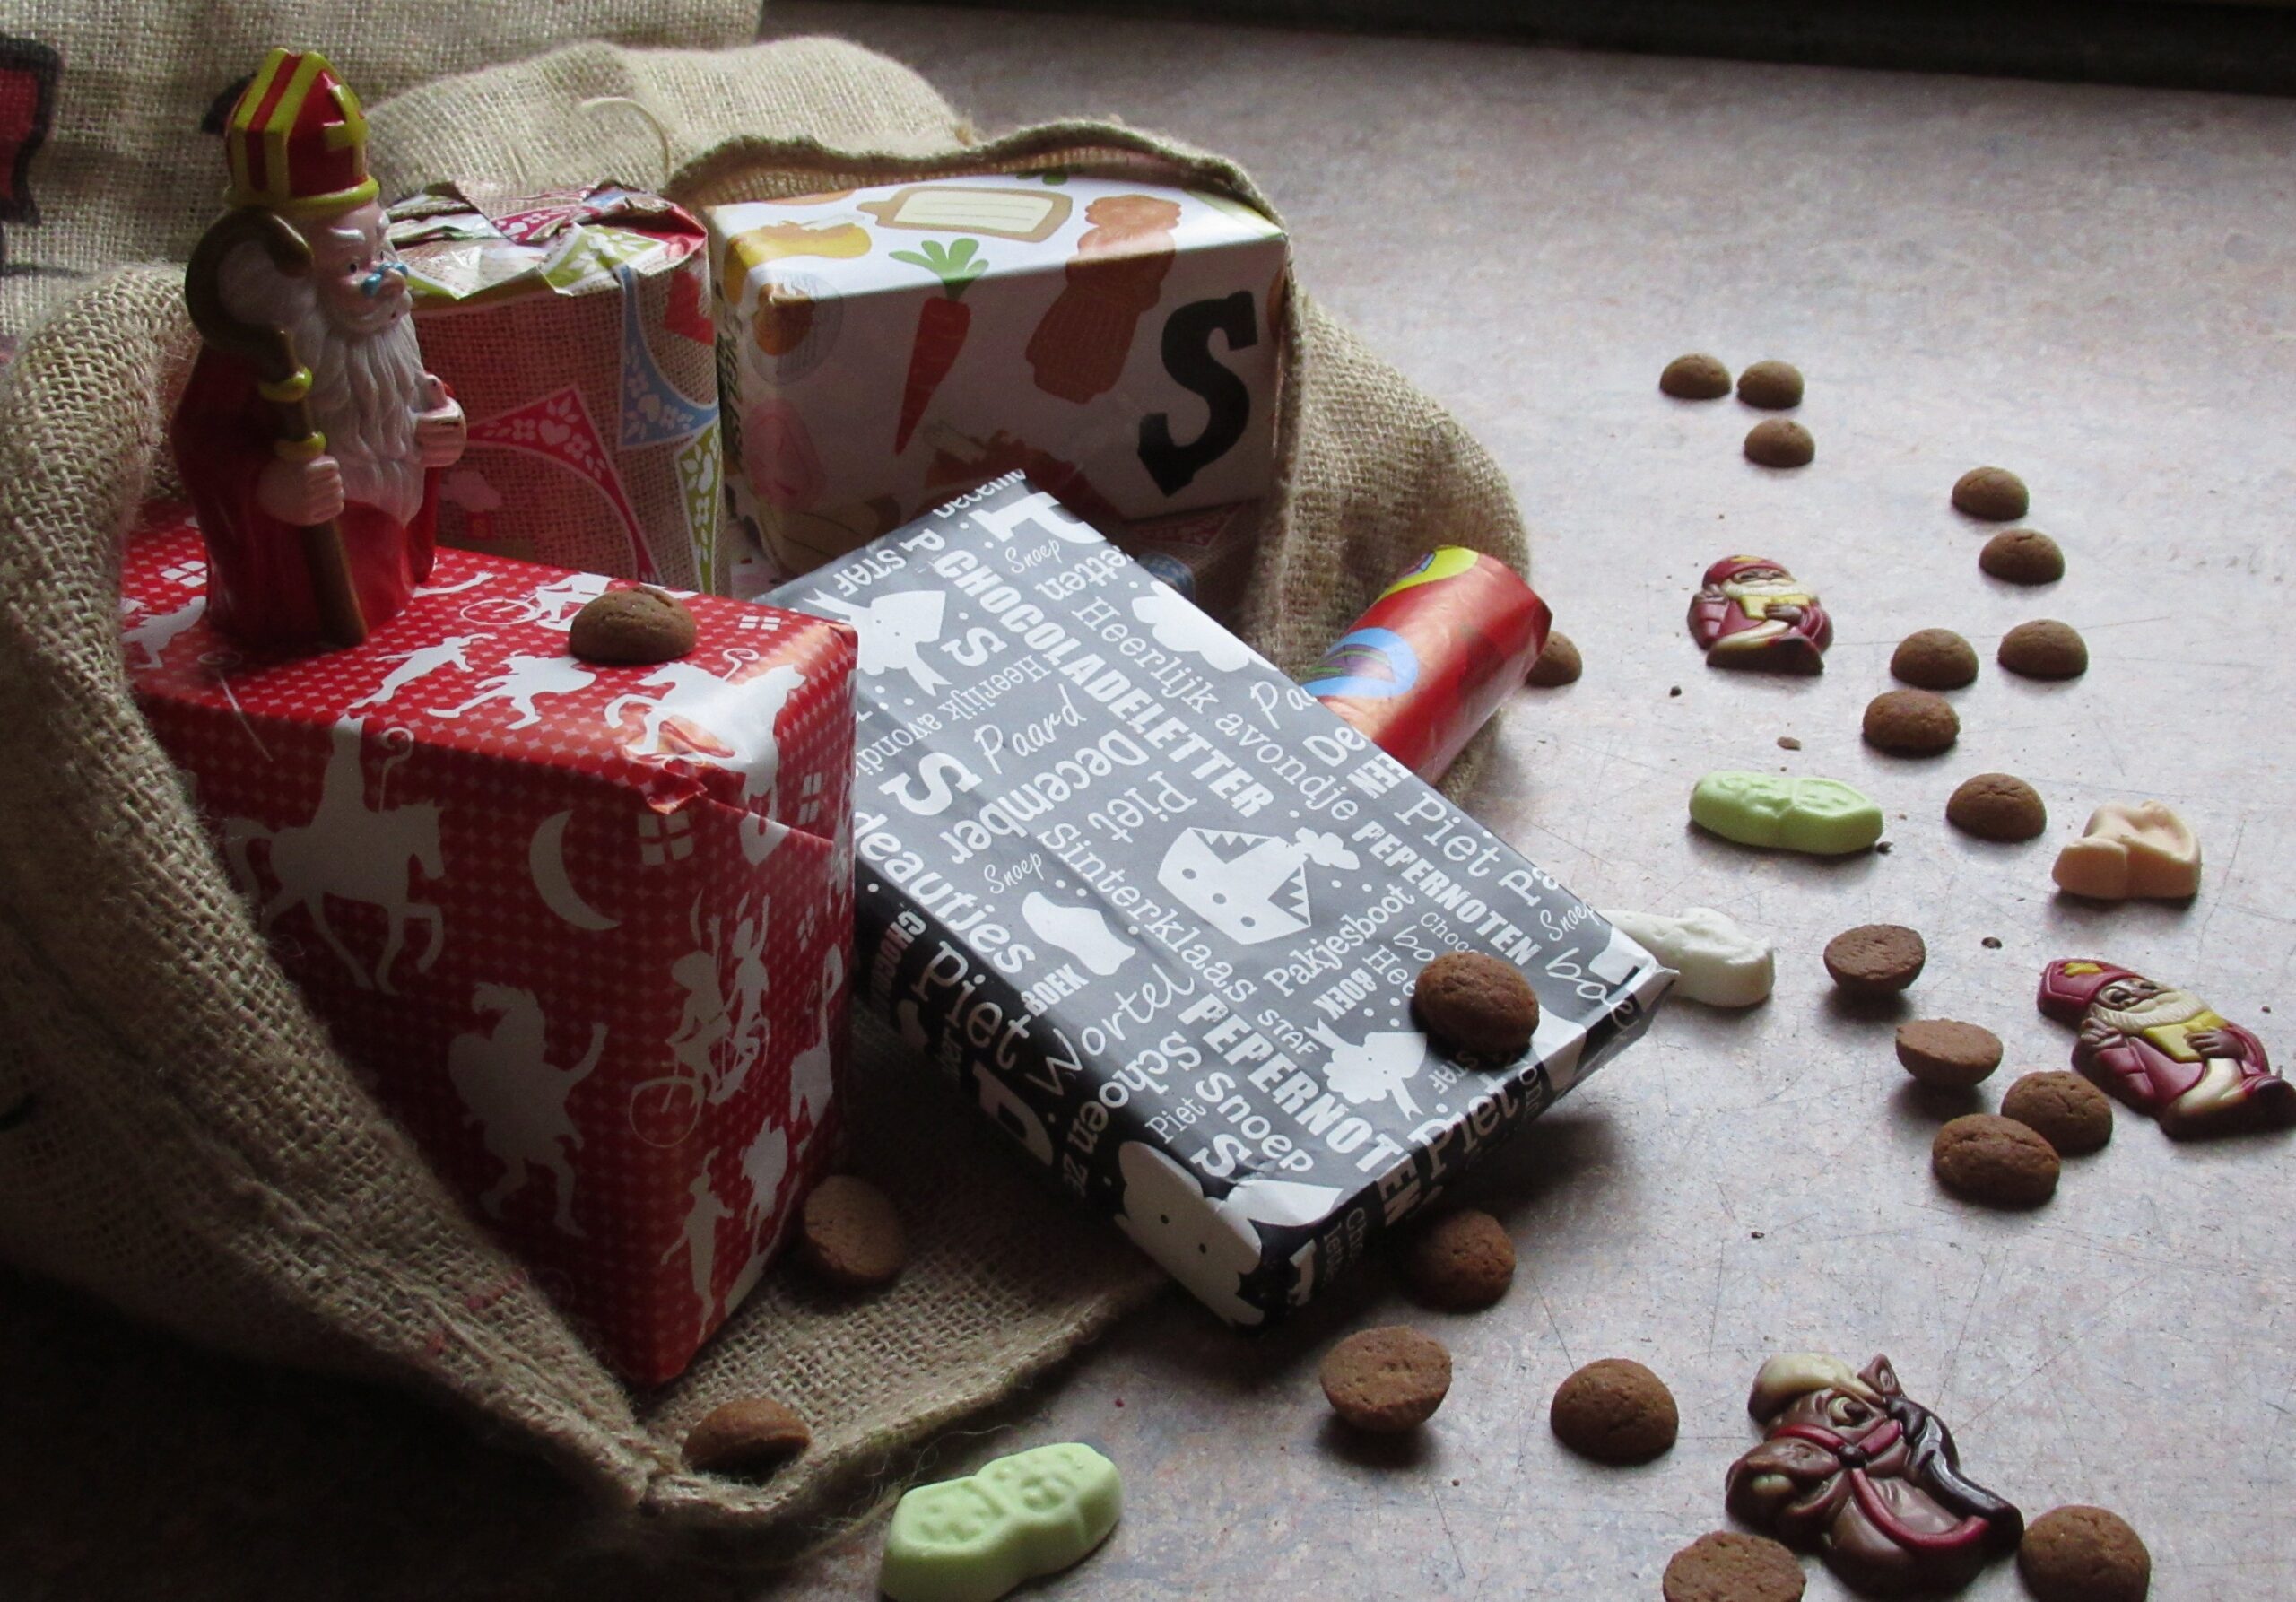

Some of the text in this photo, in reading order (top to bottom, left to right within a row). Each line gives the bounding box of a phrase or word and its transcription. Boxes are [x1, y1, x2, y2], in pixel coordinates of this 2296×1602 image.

[1137, 289, 1259, 498] S
[1004, 539, 1061, 574] Snoep
[1034, 544, 1135, 600] etten
[936, 549, 1274, 819] CHOCOLADELETTER
[939, 654, 1053, 723] Heerlijk
[973, 683, 1088, 775] Paard
[1071, 596, 1360, 820] Heerlijk avondje
[1302, 726, 1368, 767] De
[940, 729, 1151, 866] December
[1088, 770, 1199, 844] Piet
[1394, 792, 1504, 878] Piet
[983, 852, 1045, 895] Snoep
[1038, 823, 1258, 1003] Sinterklaas
[1351, 820, 1542, 967] PEPERNOTEN
[1263, 883, 1417, 997] Pakjesboot
[1421, 911, 1480, 954] Choc
[910, 940, 1031, 1070] Piet
[1020, 963, 1089, 1017] BOEK
[1024, 963, 1196, 1097] Wortel
[1257, 1008, 1323, 1058] STAF
[1314, 968, 1378, 1022] BOEK
[1067, 1030, 1203, 1155] Schoen
[1144, 1097, 1207, 1145] Piet
[1178, 993, 1423, 1228] PEPERNOTEN
[1195, 1071, 1315, 1174] Snoep
[1406, 1072, 1519, 1181] Piet
